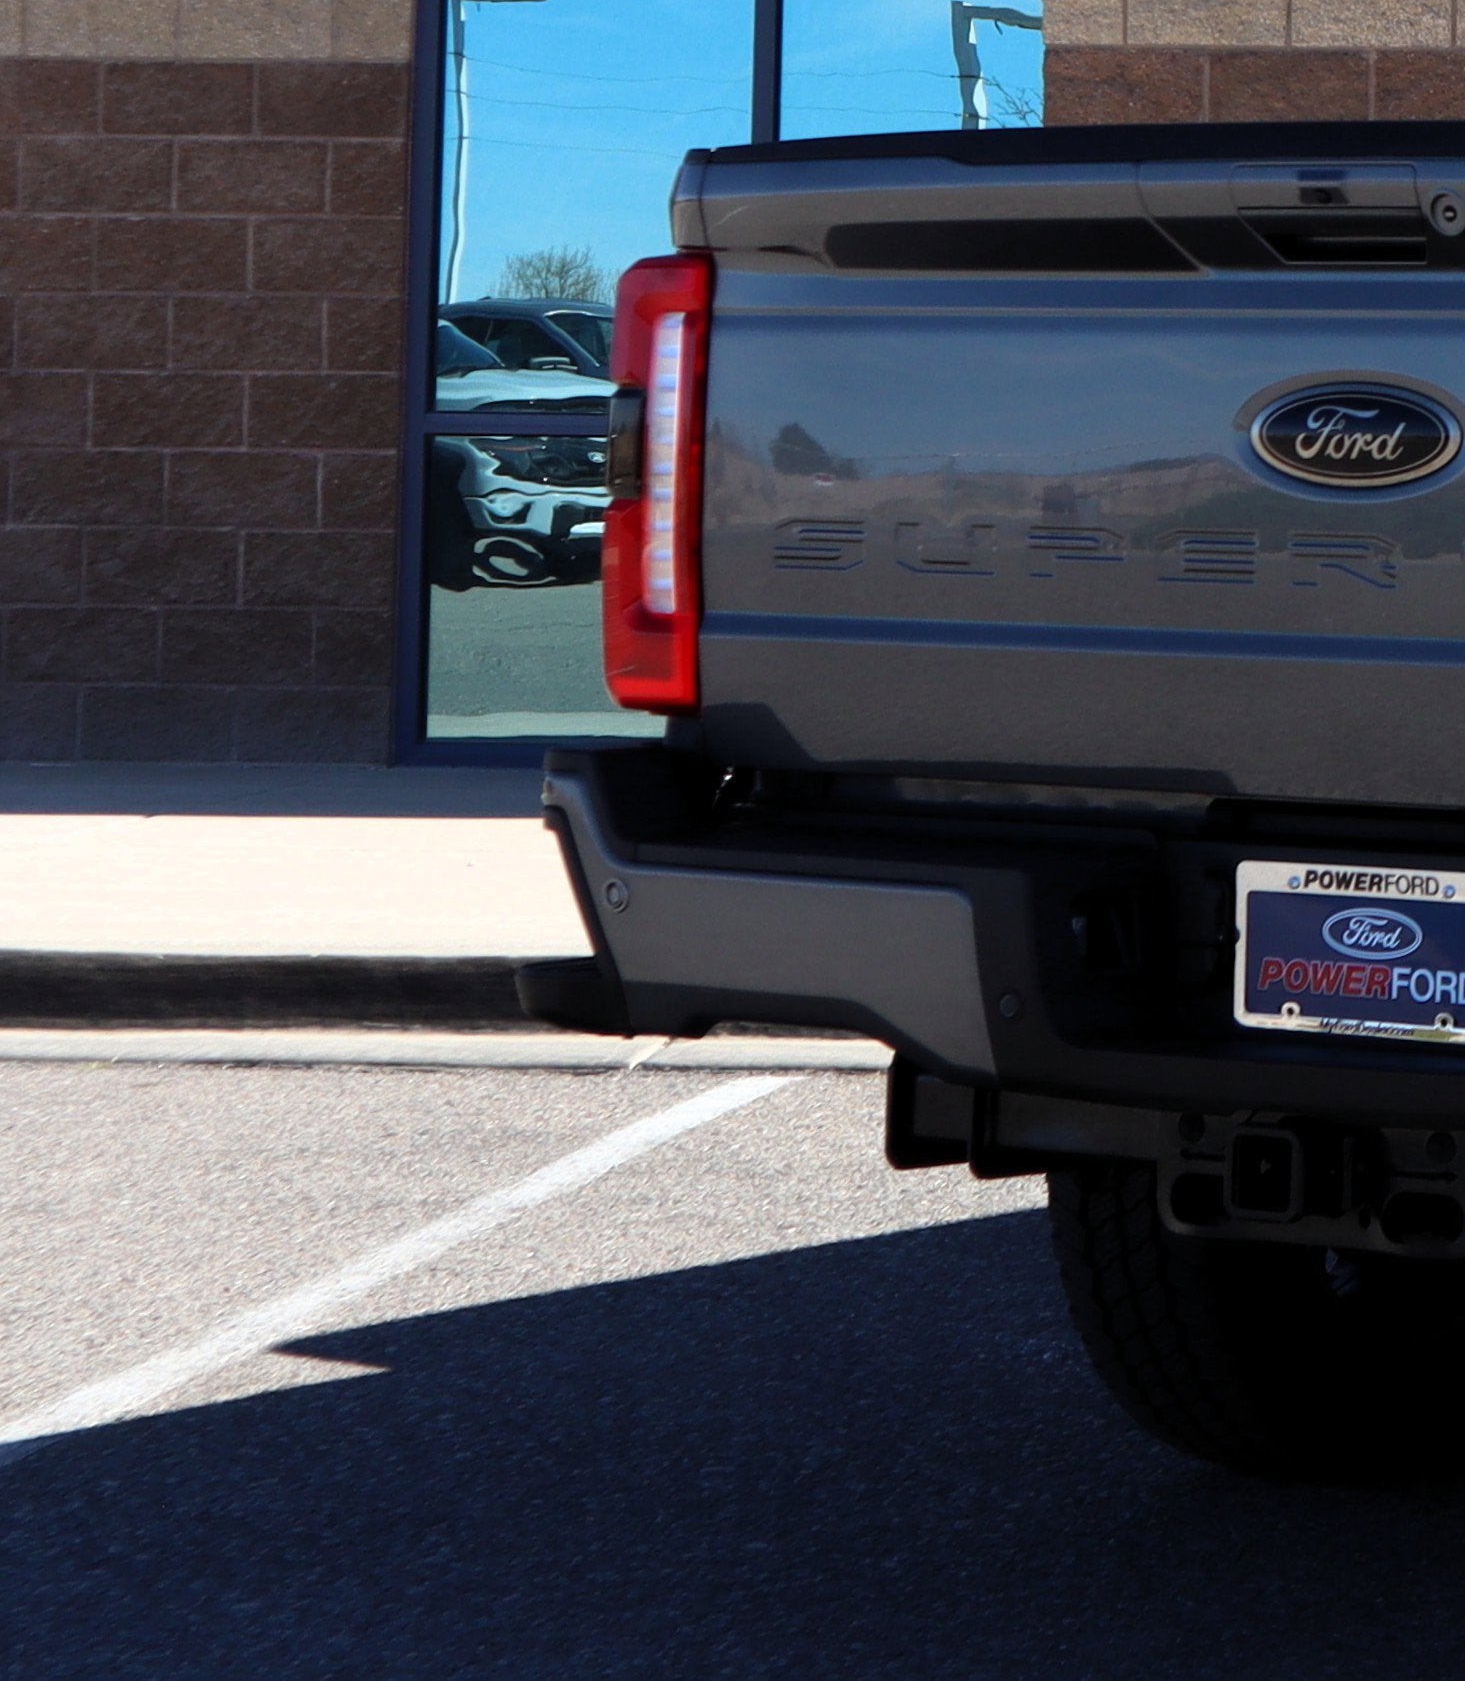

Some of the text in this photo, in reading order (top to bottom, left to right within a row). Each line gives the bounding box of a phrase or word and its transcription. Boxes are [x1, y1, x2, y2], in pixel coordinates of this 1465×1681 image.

[1294, 407, 1404, 462] Ford
[774, 518, 1399, 590] SUPER
[1302, 869, 1441, 897] POWERFORD
[1342, 916, 1403, 950] Ford
